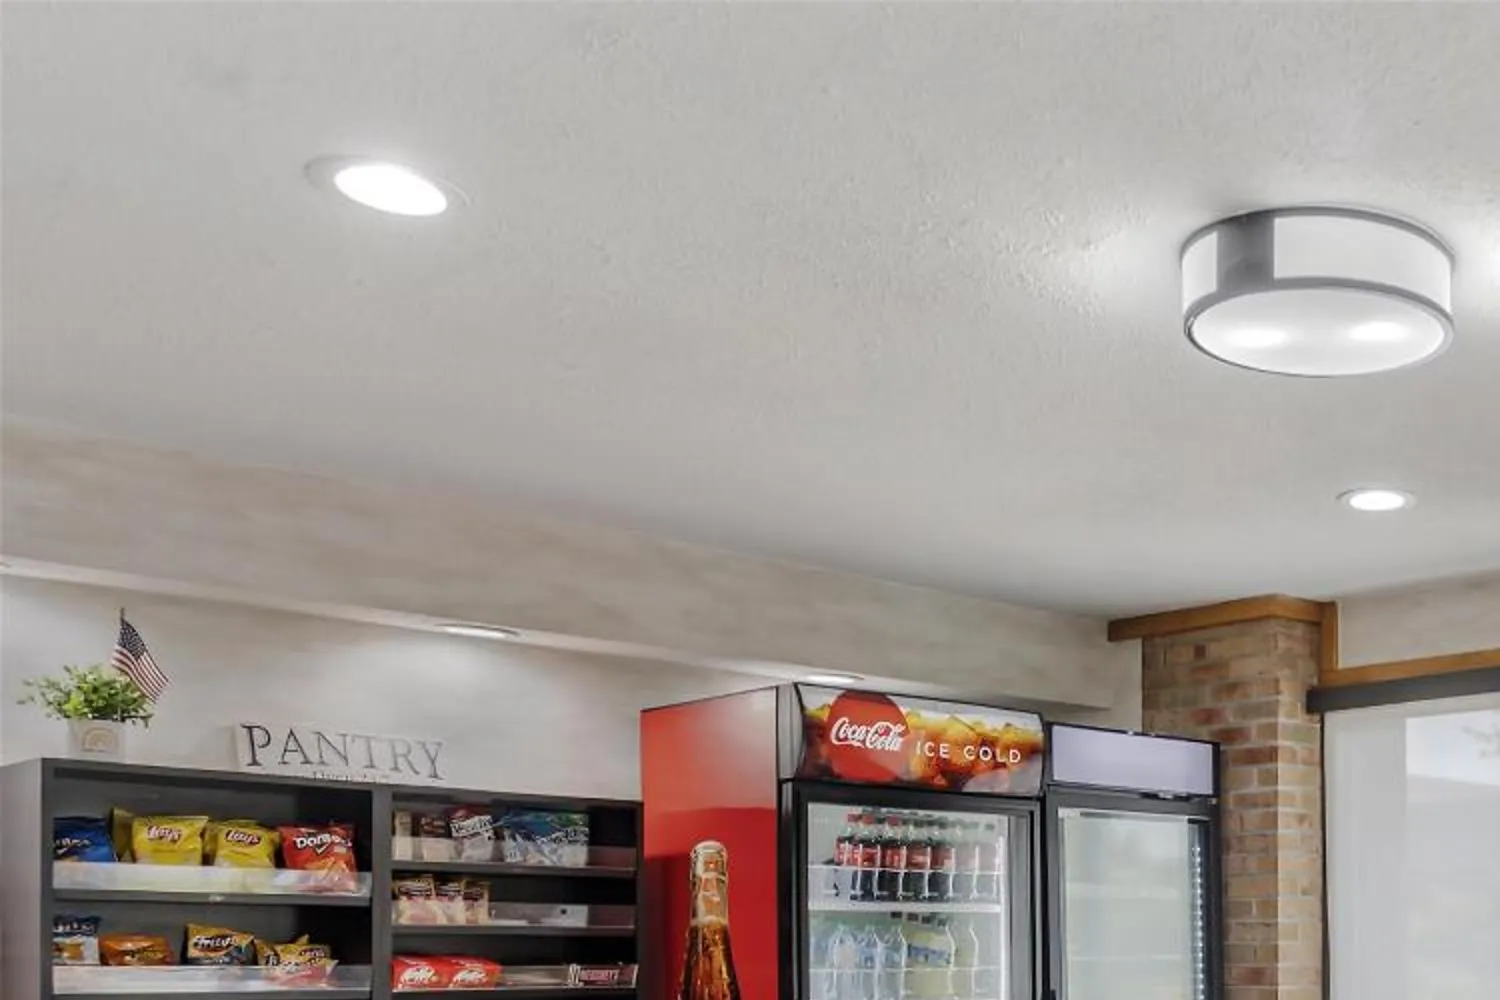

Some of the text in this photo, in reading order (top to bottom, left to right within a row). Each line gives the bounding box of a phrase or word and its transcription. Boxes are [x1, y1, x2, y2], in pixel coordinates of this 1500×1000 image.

[830, 717, 907, 751] Coca-Cola
[240, 723, 444, 780] PANTRY
[916, 742, 1021, 763] ICE COLD
